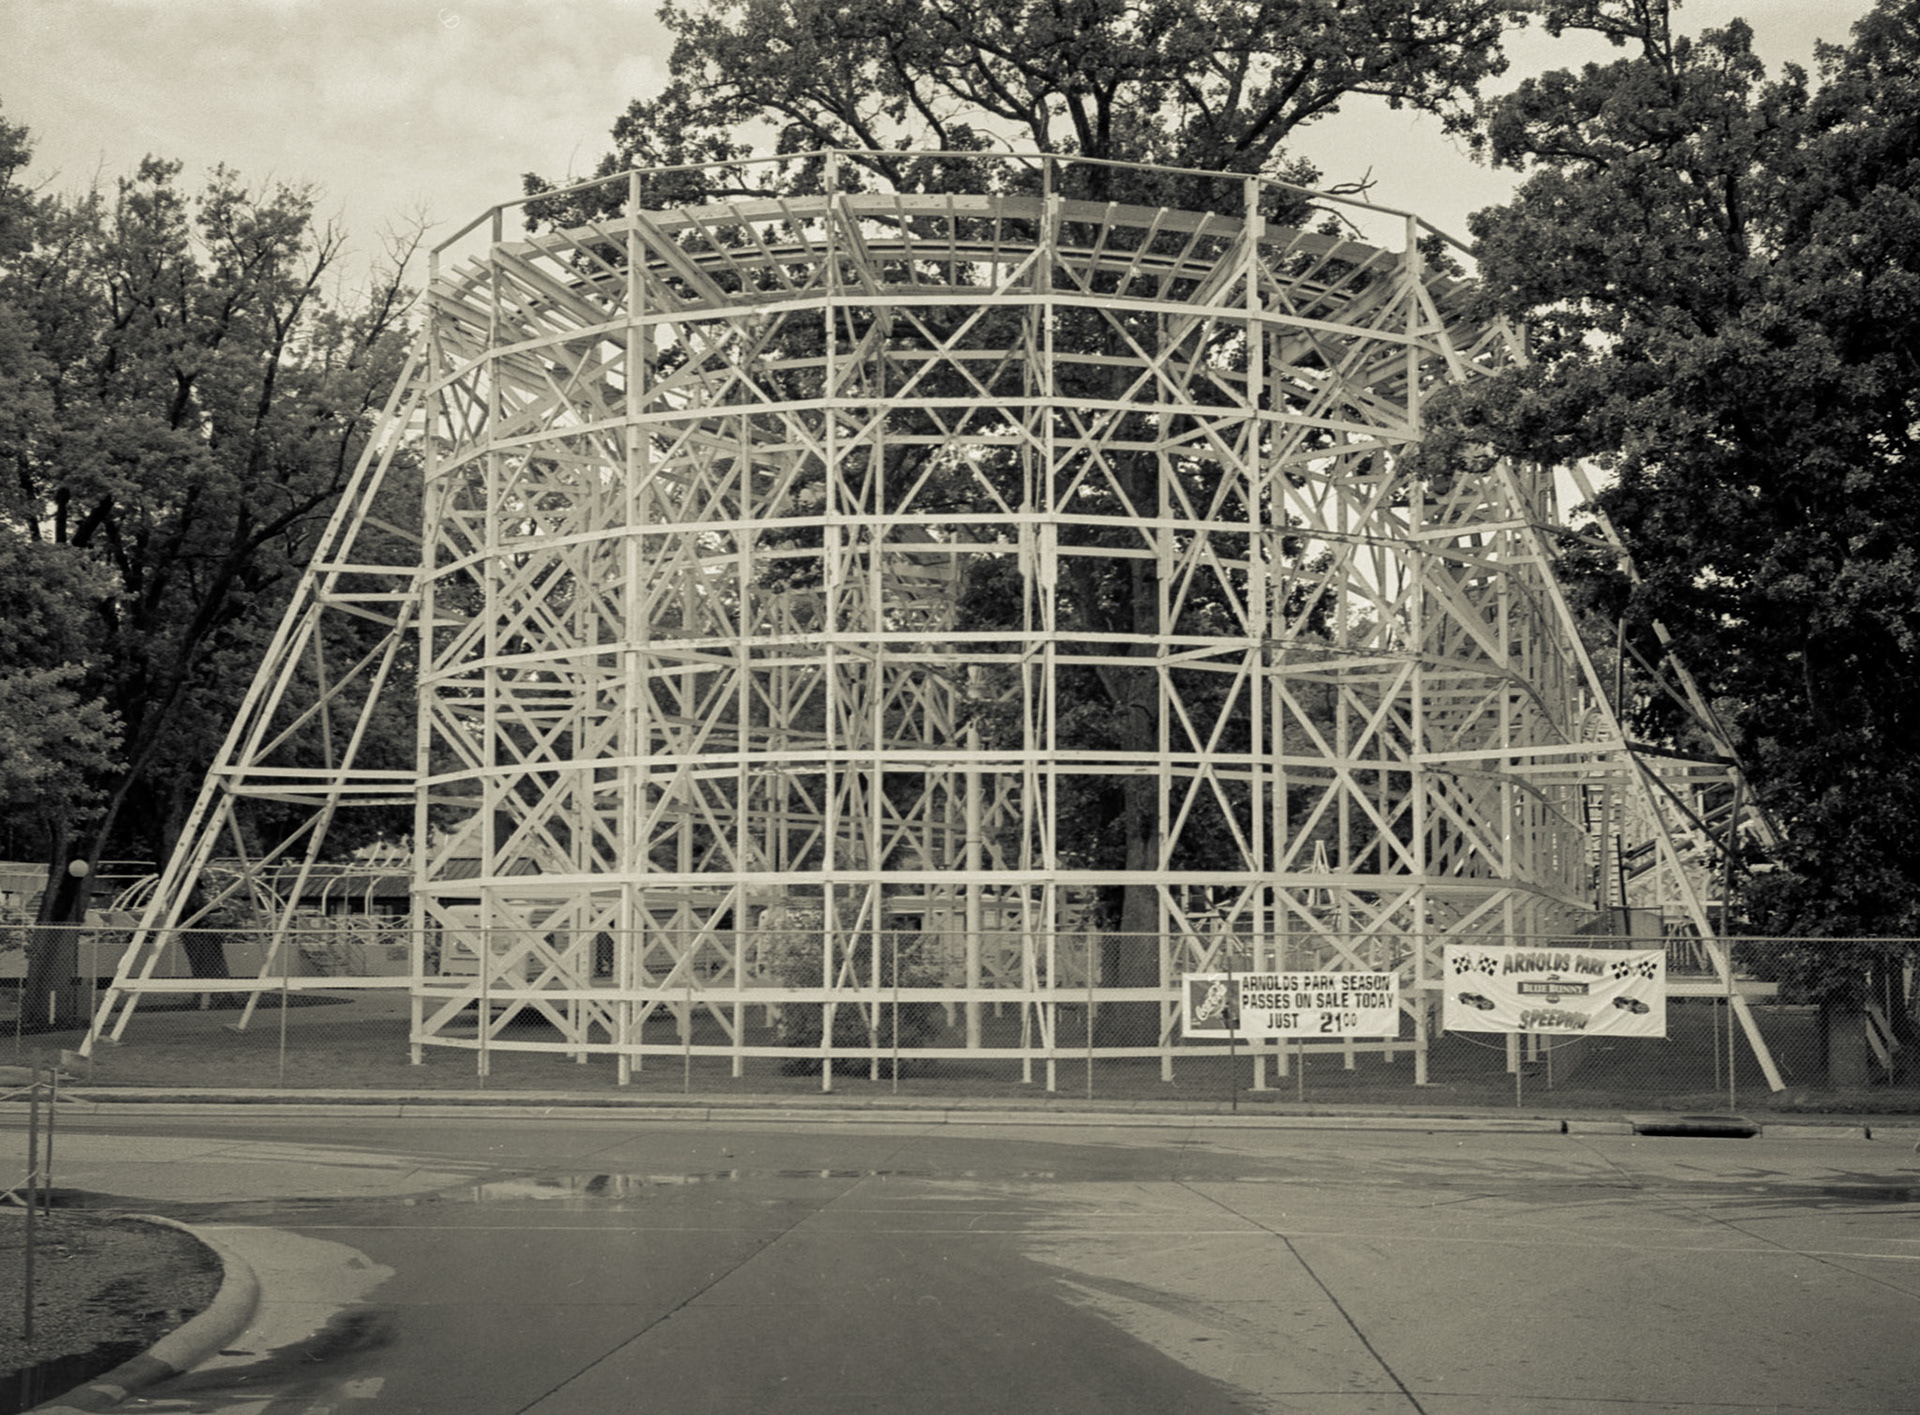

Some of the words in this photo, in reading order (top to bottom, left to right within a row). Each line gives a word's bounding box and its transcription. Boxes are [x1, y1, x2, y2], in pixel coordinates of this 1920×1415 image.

[1502, 952, 1571, 977] ARNOLDS
[1574, 954, 1606, 977] PARK
[1242, 975, 1299, 991] ARNOLDS
[1304, 975, 1336, 991] PARK
[1341, 975, 1390, 991] SEASON
[1522, 983, 1548, 993] BLUE
[1242, 993, 1291, 1009] PASSES
[1295, 992, 1312, 1009] ON
[1316, 992, 1349, 1008] SALE
[1354, 992, 1394, 1009] TODAY
[1267, 1012, 1299, 1029] JUST
